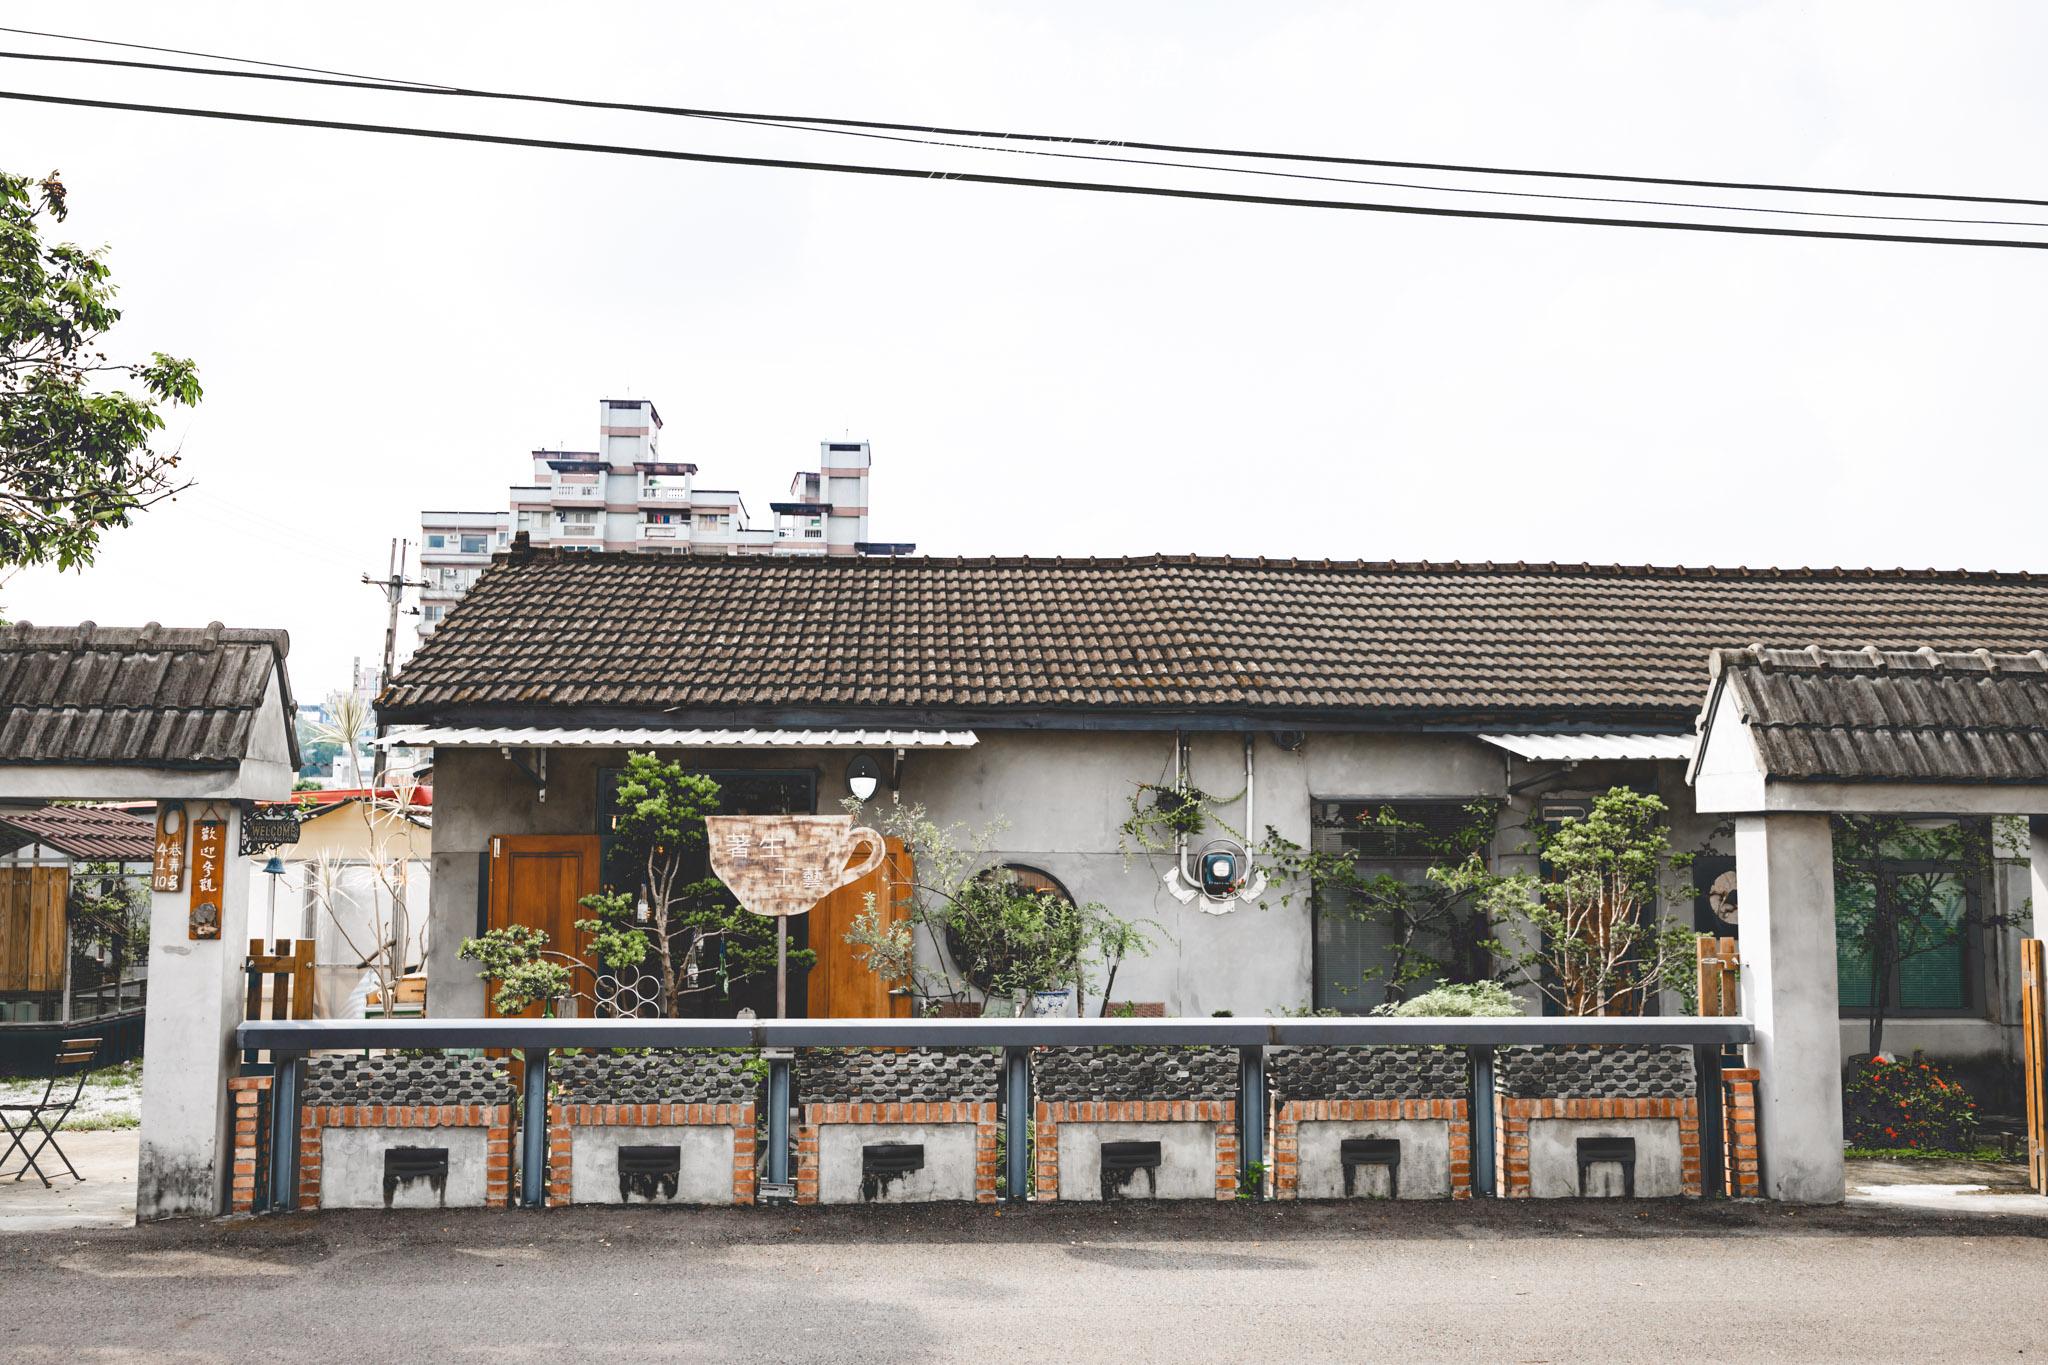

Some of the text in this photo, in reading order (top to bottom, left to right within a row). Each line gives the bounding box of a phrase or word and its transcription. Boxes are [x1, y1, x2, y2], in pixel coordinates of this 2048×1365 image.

[252, 825, 297, 837] WELCOME
[727, 833, 785, 858] 著生
[199, 826, 217, 892] 歡迎參觀
[774, 867, 824, 889] 工藝
